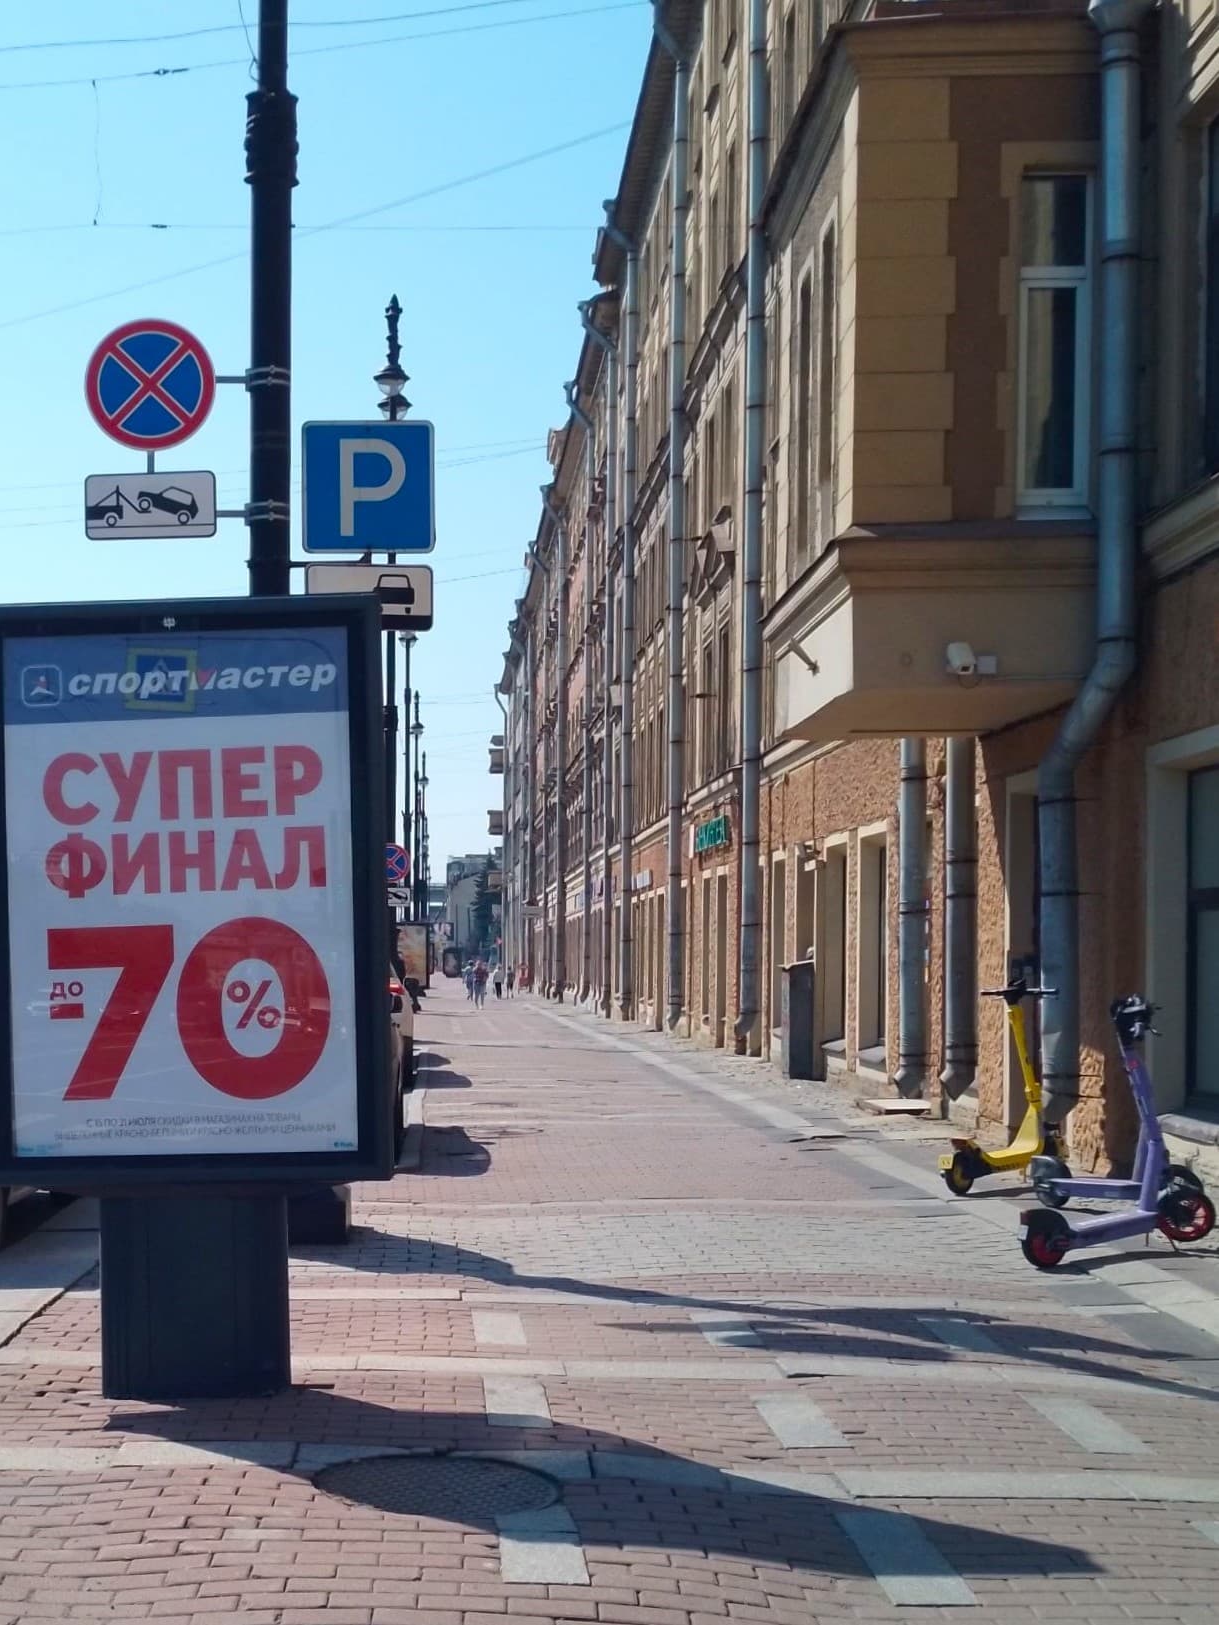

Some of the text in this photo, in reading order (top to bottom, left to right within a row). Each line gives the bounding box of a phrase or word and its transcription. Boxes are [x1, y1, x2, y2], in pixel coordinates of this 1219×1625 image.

[339, 438, 407, 537] P
[68, 663, 337, 699] спортмастер
[42, 744, 324, 826] СУПЕР
[45, 825, 328, 899] ФИНАЛ
